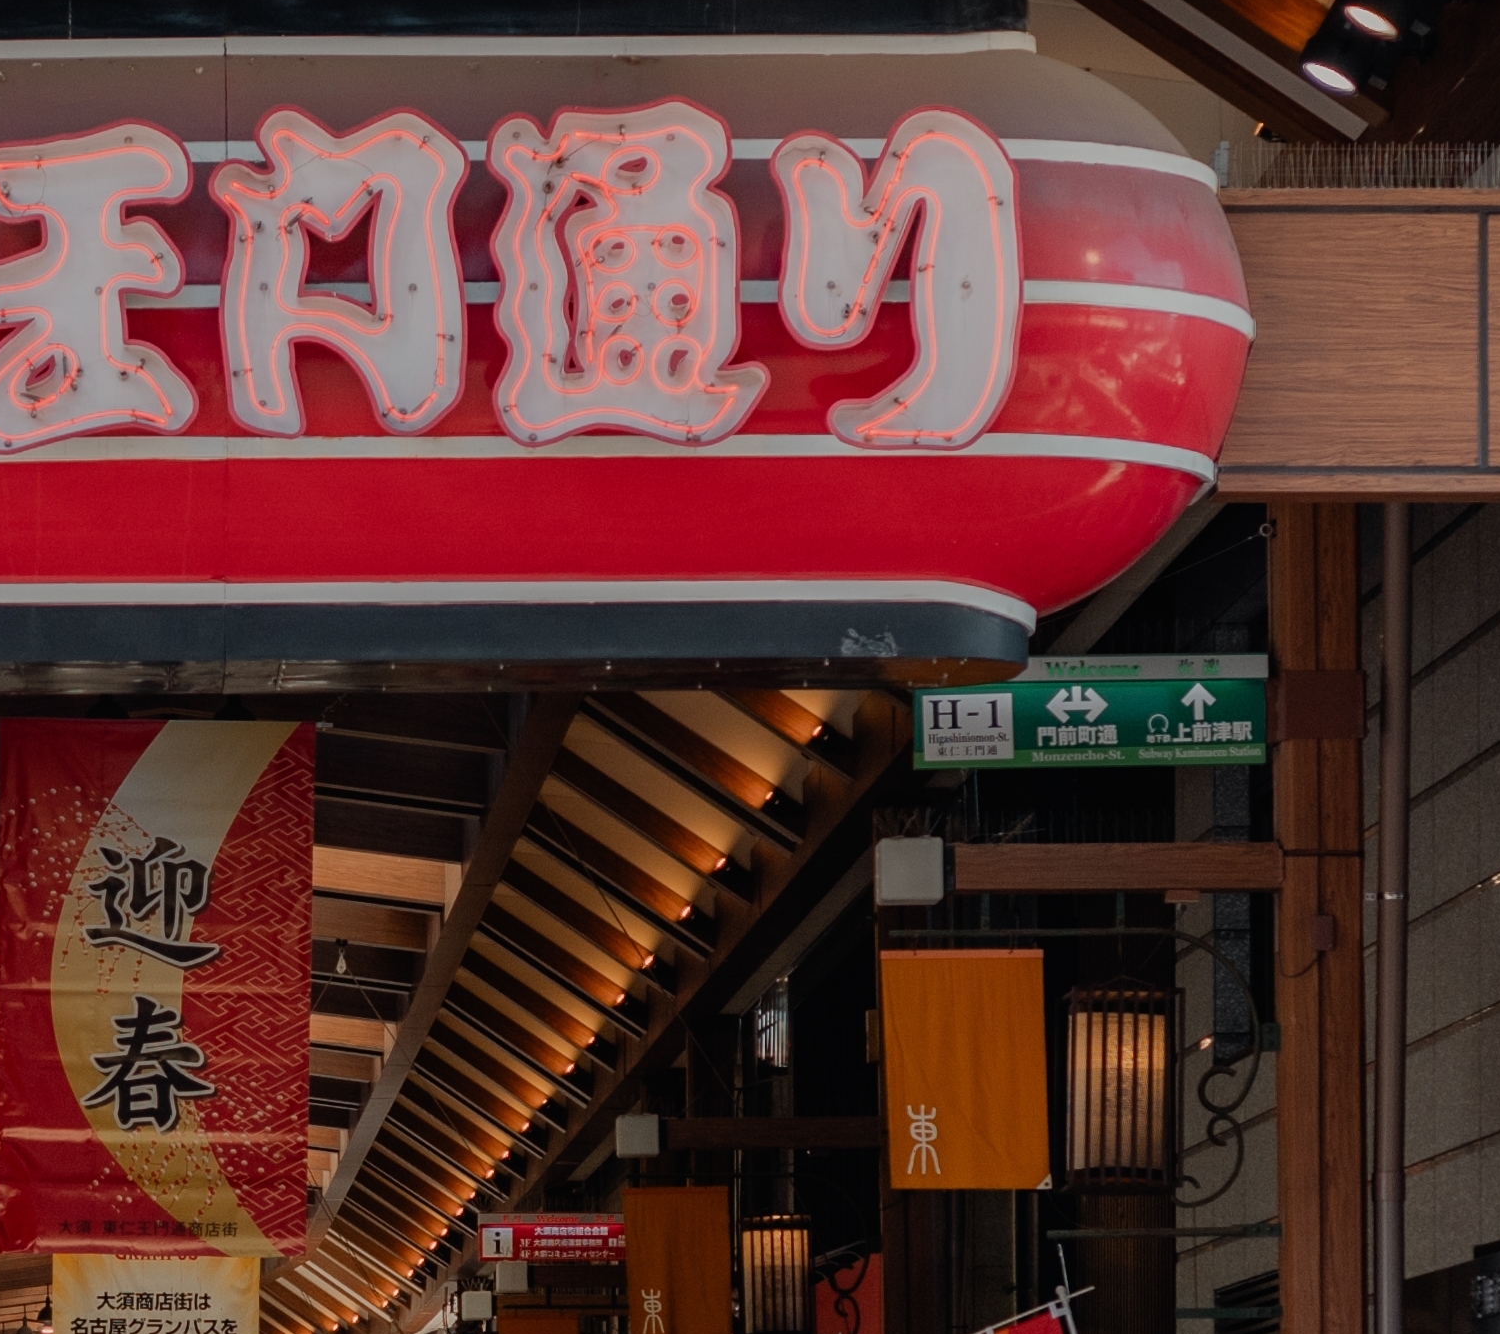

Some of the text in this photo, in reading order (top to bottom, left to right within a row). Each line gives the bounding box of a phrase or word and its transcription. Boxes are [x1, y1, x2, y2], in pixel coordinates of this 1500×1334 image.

[1045, 660, 1141, 678] Welcome
[929, 699, 1003, 729] H-1
[1037, 725, 1118, 746] 門前町通
[1172, 721, 1253, 743] 上前津駅
[937, 746, 998, 757] 東仁王門通
[1032, 750, 1126, 762] Monzencho-St.
[1138, 748, 1173, 760] Subway
[1229, 746, 1262, 757] Station
[83, 836, 221, 1134] 迎春
[907, 1104, 941, 1175] 東
[96, 1292, 211, 1311] 大須商店街は
